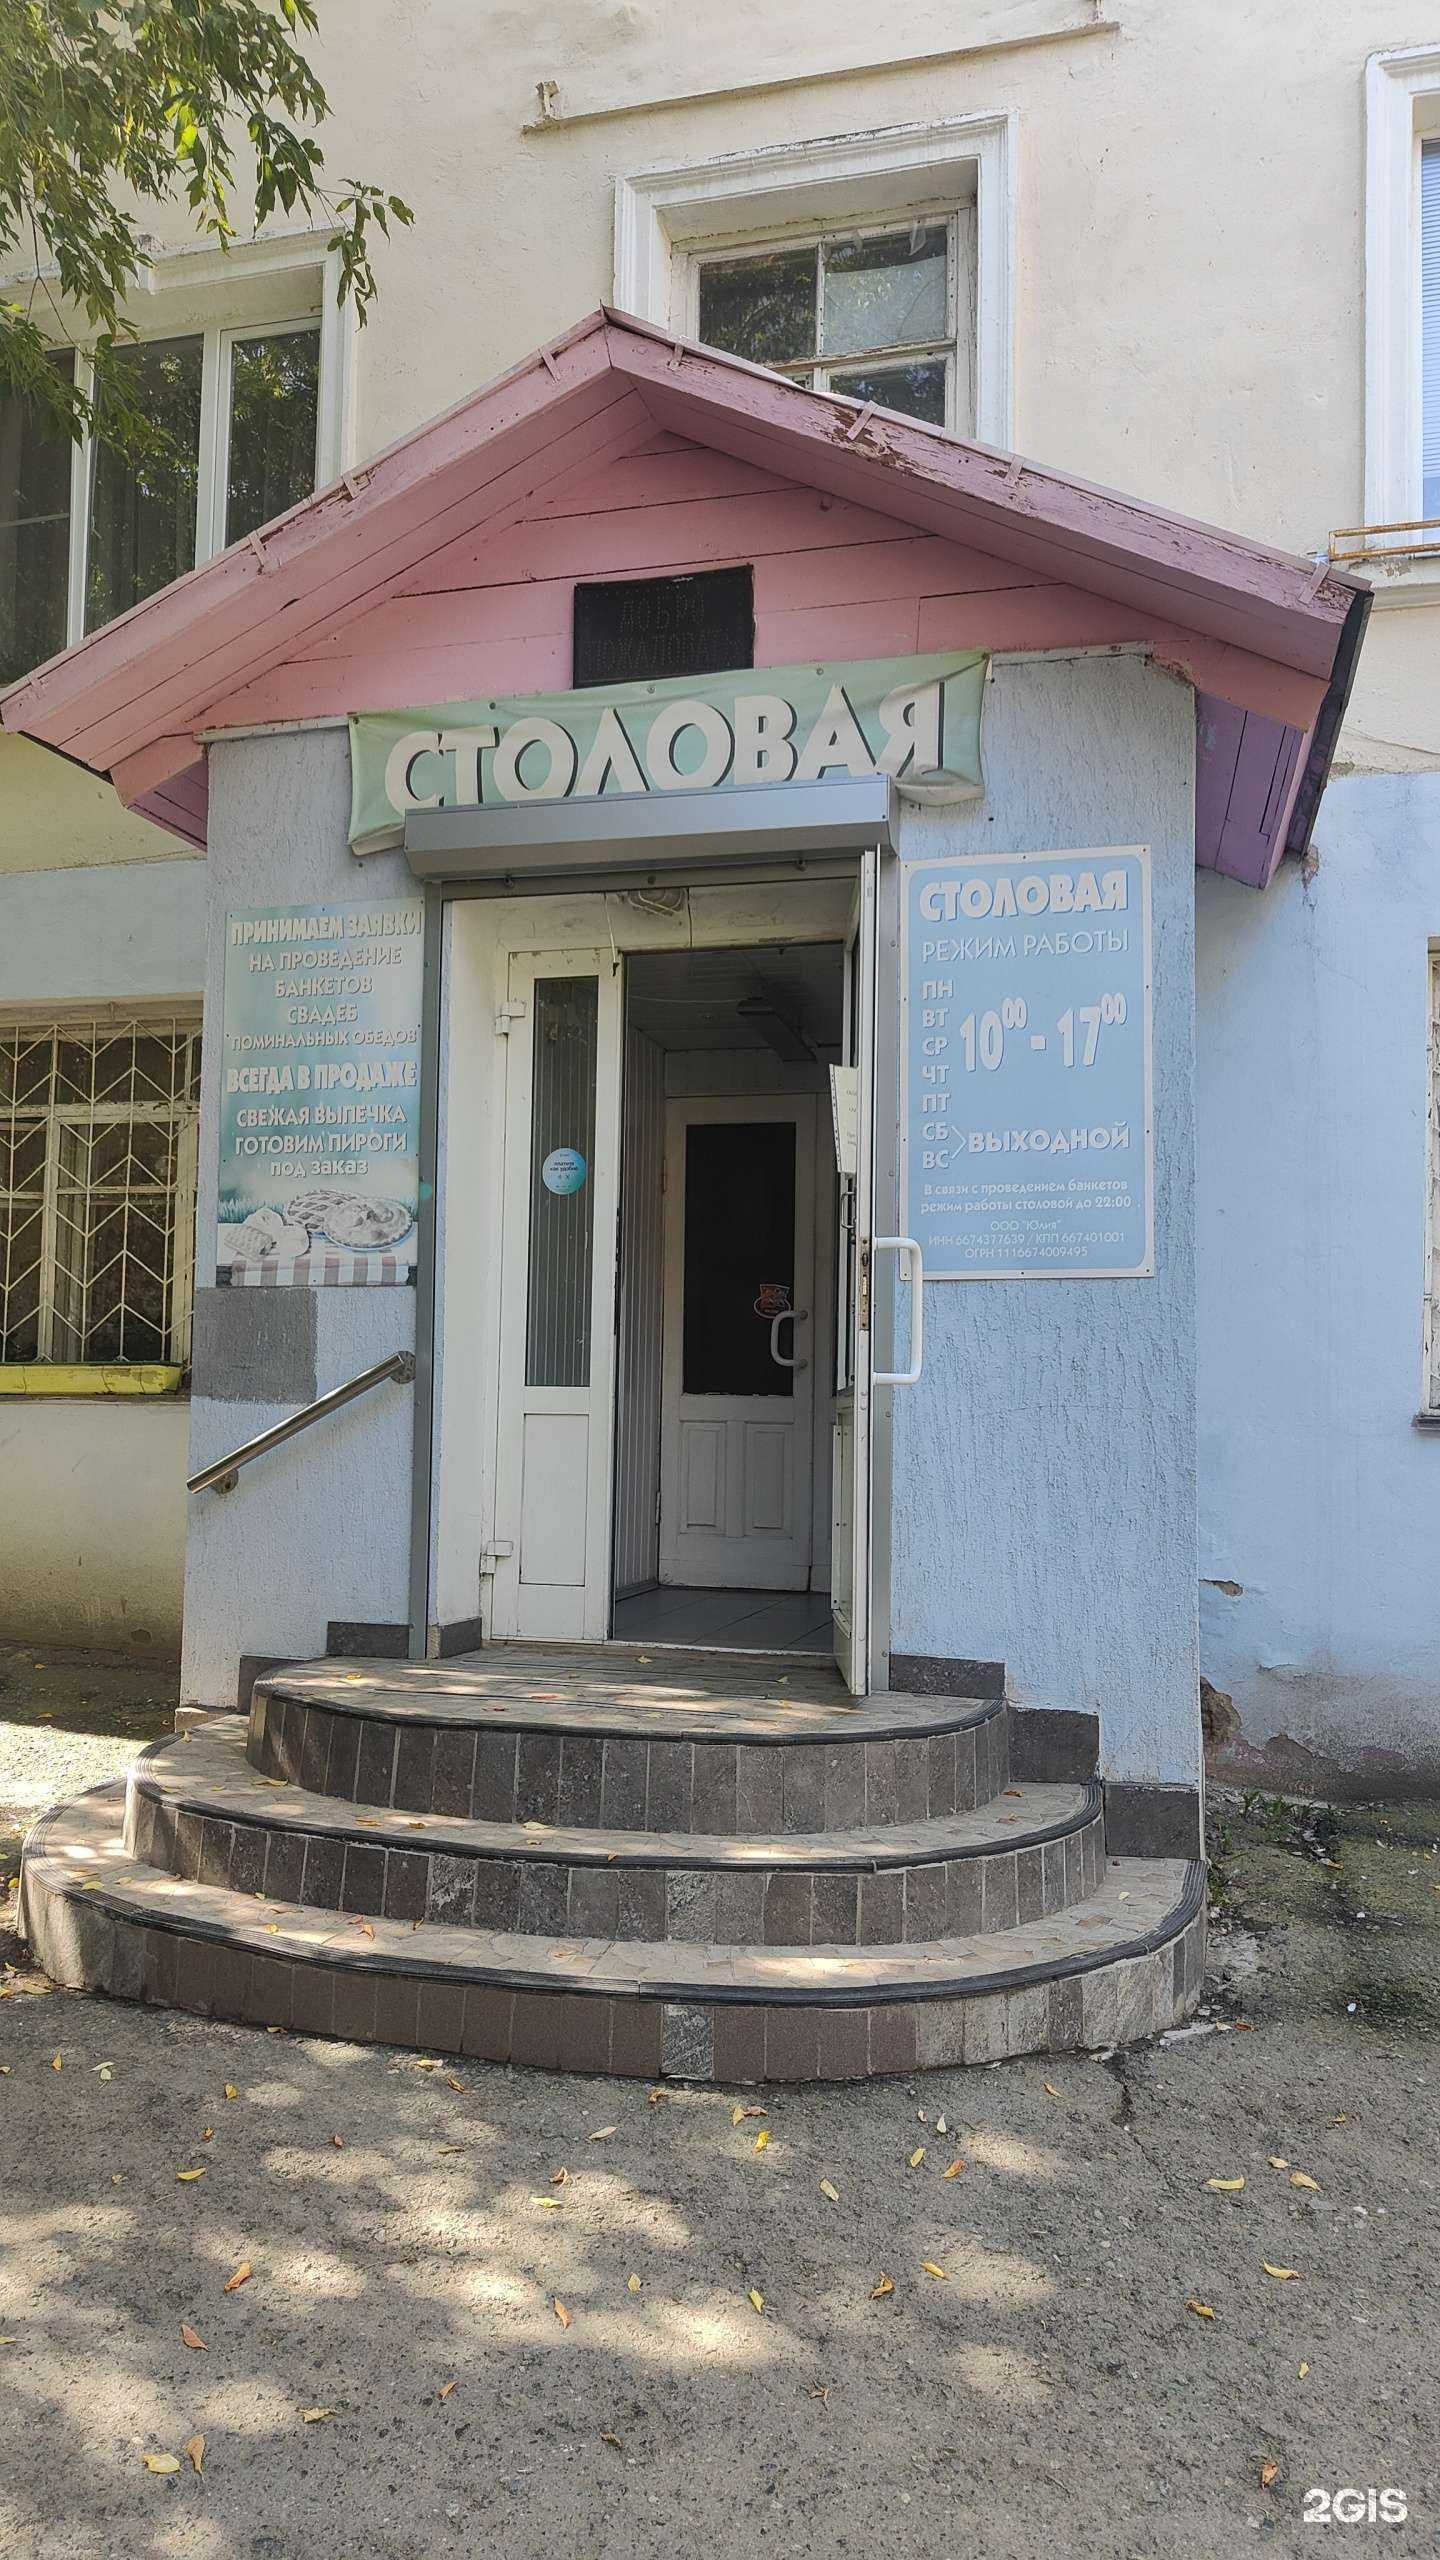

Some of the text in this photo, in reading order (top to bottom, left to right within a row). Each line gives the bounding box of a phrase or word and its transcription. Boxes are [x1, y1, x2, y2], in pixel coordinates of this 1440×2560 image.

[385, 682, 945, 815] СТОЛОВАЯ
[919, 869, 1129, 922] СТОЛОВАЯ
[232, 911, 422, 946] ПРИНИМАЕМ ЗАЯВКИ
[922, 928, 1129, 963] РЕЖИМ РАБОТЫ
[250, 946, 402, 972] НА ПРОВЕДЕНИЕ
[275, 976, 373, 998] БАНКЕТОВ
[922, 979, 953, 1000] ПН
[288, 1003, 358, 1026] СВАДЕБ
[922, 1008, 949, 1028] ВТ
[232, 1030, 417, 1051] ПОМИНАЛЬНЫХ ОБЕДОВ
[922, 1036, 949, 1056] СР
[226, 1061, 417, 1095] ВСЕГДА В ПРОДАЖЕ
[921, 1064, 950, 1084] ЧТ
[922, 1092, 950, 1113] ПТ
[236, 1104, 407, 1128] СВЕЖАЯ ВЫПЕЧКА
[922, 1122, 949, 1141] СБ
[968, 1121, 1130, 1154] ВЫХОДНОЙ
[235, 1132, 407, 1155] ГОТОВИМ ПИРОГИ
[271, 1160, 368, 1178] под заказ
[922, 1151, 950, 1169] ВС
[924, 1179, 1128, 1197] В связи с проведением банкетов
[921, 1200, 962, 1215] режим
[965, 1199, 1012, 1214] работы
[1015, 1198, 1073, 1211] столовой
[1076, 1199, 1092, 1211] до
[990, 1220, 1019, 1232] ООО
[928, 1235, 953, 1246] ИНН
[1035, 1233, 1059, 1244] КПП
[964, 1248, 994, 1259] ОГРН
